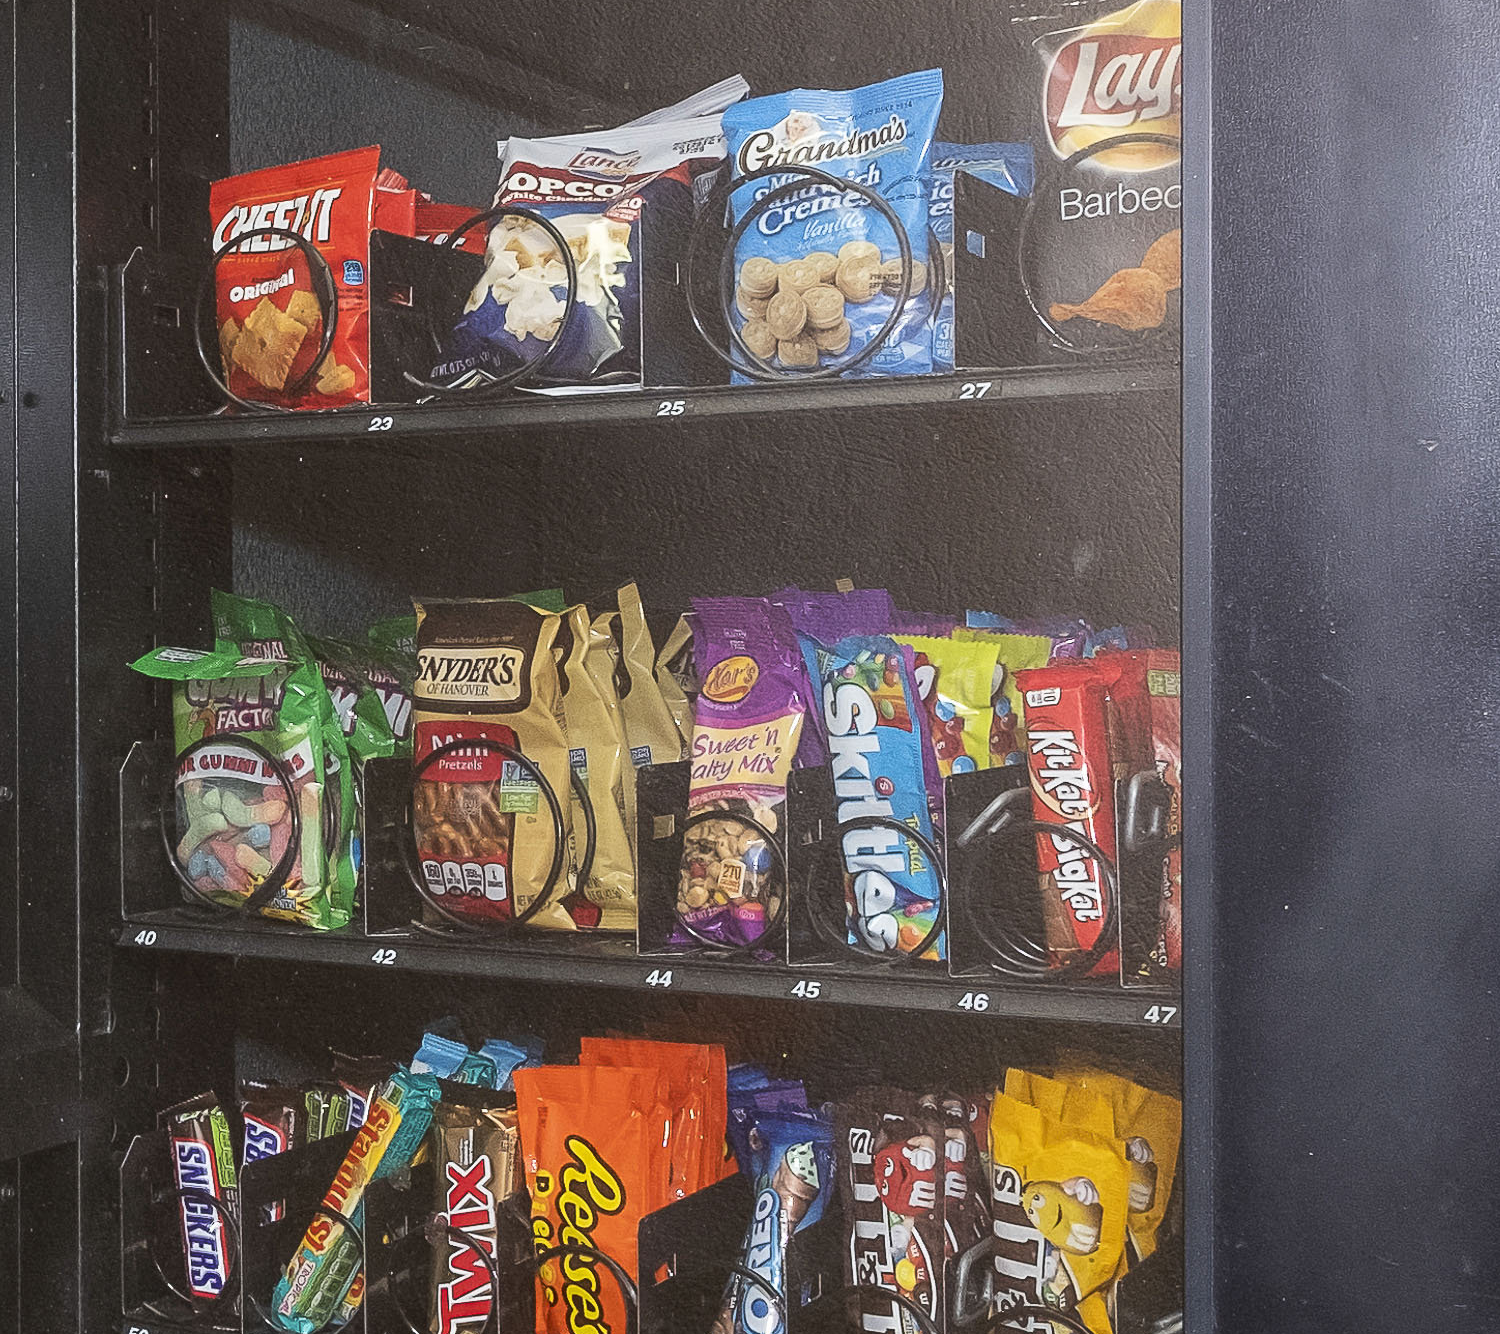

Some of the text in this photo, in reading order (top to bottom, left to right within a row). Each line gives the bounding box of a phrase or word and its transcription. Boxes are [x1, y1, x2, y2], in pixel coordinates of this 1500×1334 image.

[1058, 41, 1181, 127] Lay
[738, 115, 907, 175] Grandma's
[573, 149, 642, 169] Lance
[758, 192, 871, 235] Cremes
[803, 212, 866, 240] Vanilla
[959, 383, 992, 399] 27
[656, 400, 686, 416] 25
[368, 417, 393, 431] 23
[416, 654, 516, 687] SNYDER'S
[440, 683, 489, 696] HANOVER
[693, 733, 760, 759] Sweet
[438, 758, 483, 771] Pretzels
[740, 754, 777, 774] Mix
[823, 682, 905, 952] Skittles
[135, 931, 157, 946] 40
[372, 949, 397, 965] 42
[645, 971, 673, 987] 44
[792, 982, 821, 998] 45
[958, 993, 989, 1012] 46
[1144, 1006, 1177, 1024] 47
[175, 1141, 223, 1295] SNICKERS
